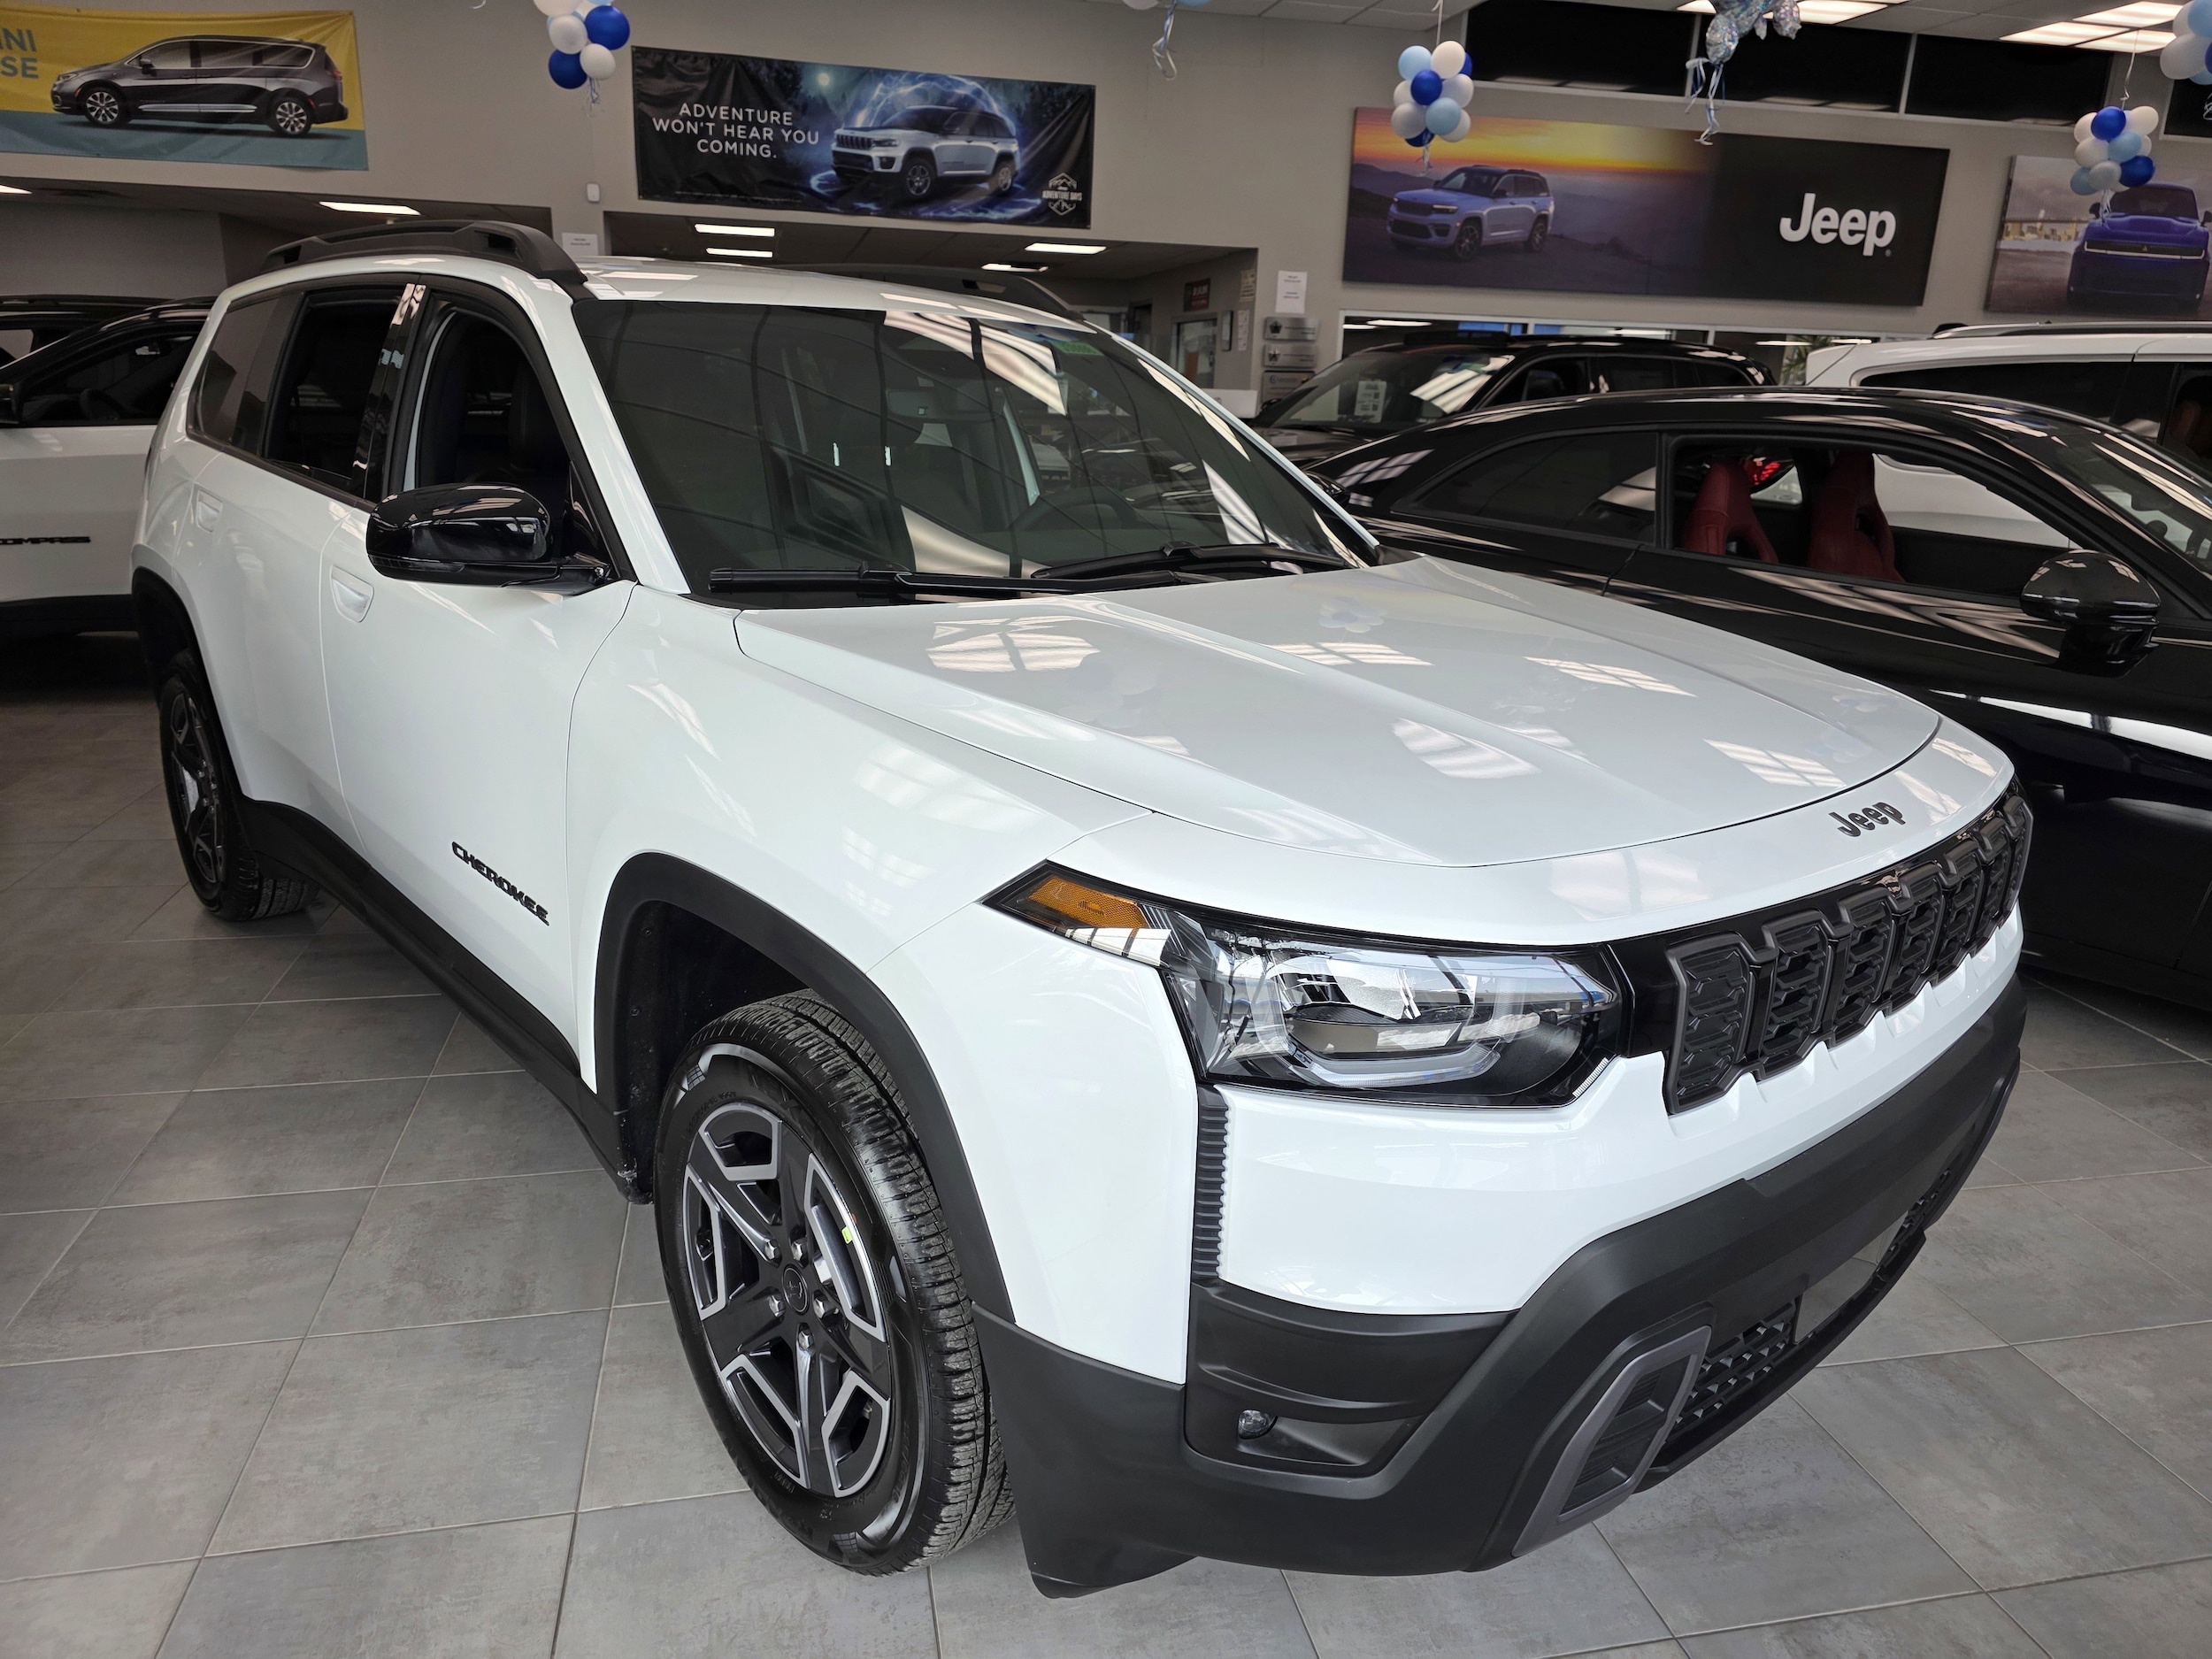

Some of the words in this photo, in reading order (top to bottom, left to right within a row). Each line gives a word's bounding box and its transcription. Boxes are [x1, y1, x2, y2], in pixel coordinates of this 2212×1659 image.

[0, 27, 37, 52] NI
[679, 103, 793, 126] ADVENTURE
[652, 118, 715, 136] WON'T
[724, 124, 773, 142] HEAR
[781, 128, 819, 145] YOU
[696, 139, 777, 159] COMING.
[1779, 193, 1896, 256] Jeep
[1828, 802, 1906, 837] Jeep
[451, 841, 549, 926] CHEROKEE
